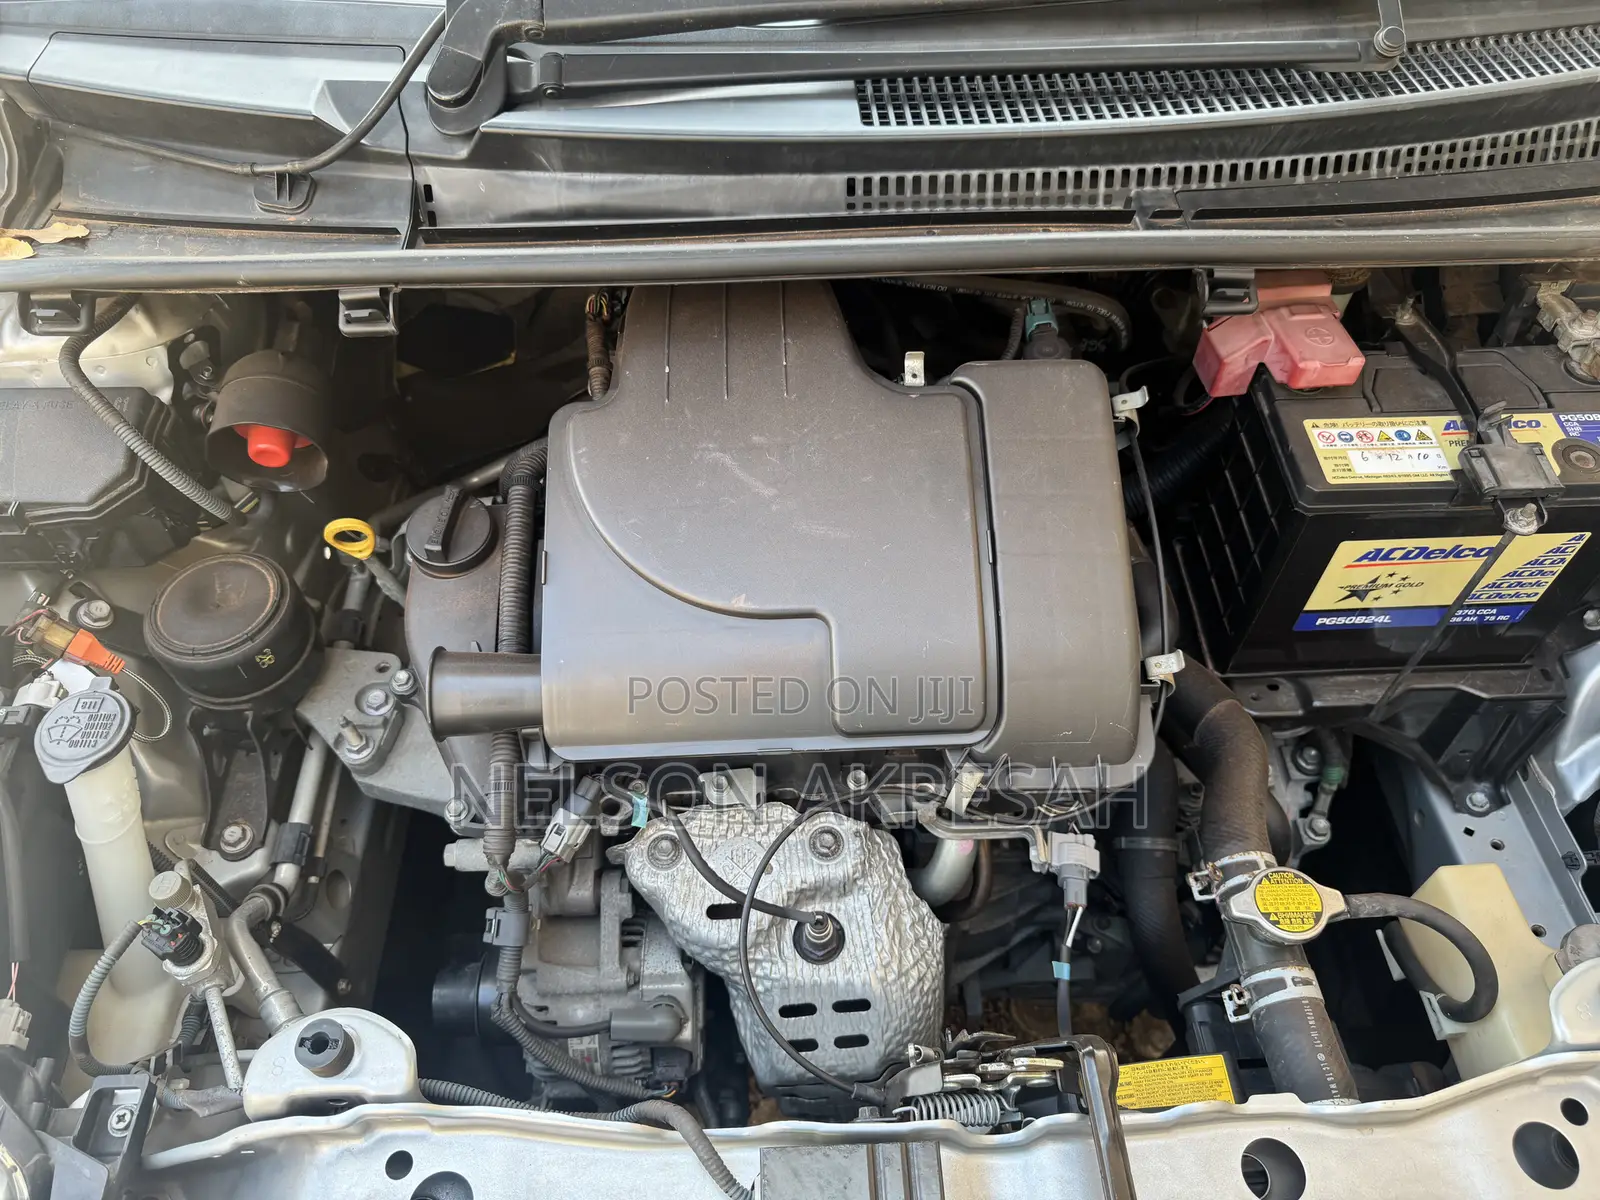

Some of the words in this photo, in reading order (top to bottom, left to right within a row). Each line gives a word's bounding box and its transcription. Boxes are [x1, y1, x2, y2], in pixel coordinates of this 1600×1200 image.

[1352, 544, 1496, 563] ACDelco
[1344, 582, 1394, 590] PREMIUM
[1394, 581, 1425, 589] GOLD
[1315, 615, 1393, 626] PG50B24L
